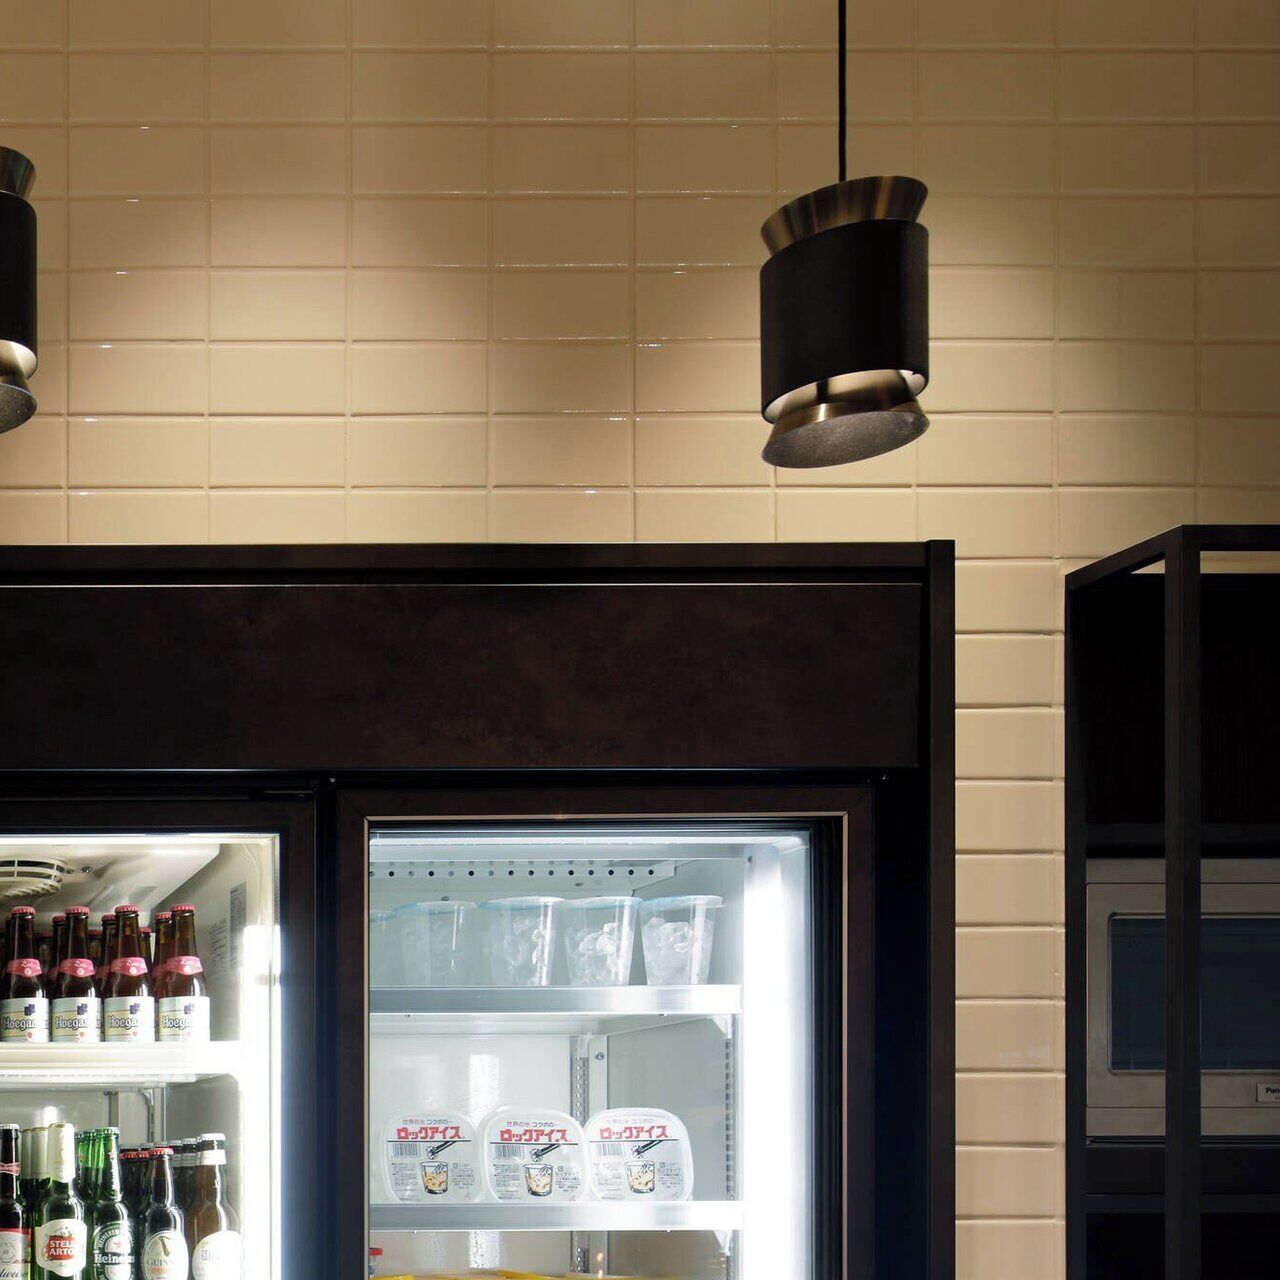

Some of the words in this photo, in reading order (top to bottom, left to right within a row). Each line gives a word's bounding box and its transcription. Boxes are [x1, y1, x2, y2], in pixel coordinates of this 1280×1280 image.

[397, 1126, 462, 1140] ロックアイス
[500, 1129, 569, 1142] ロックアイス
